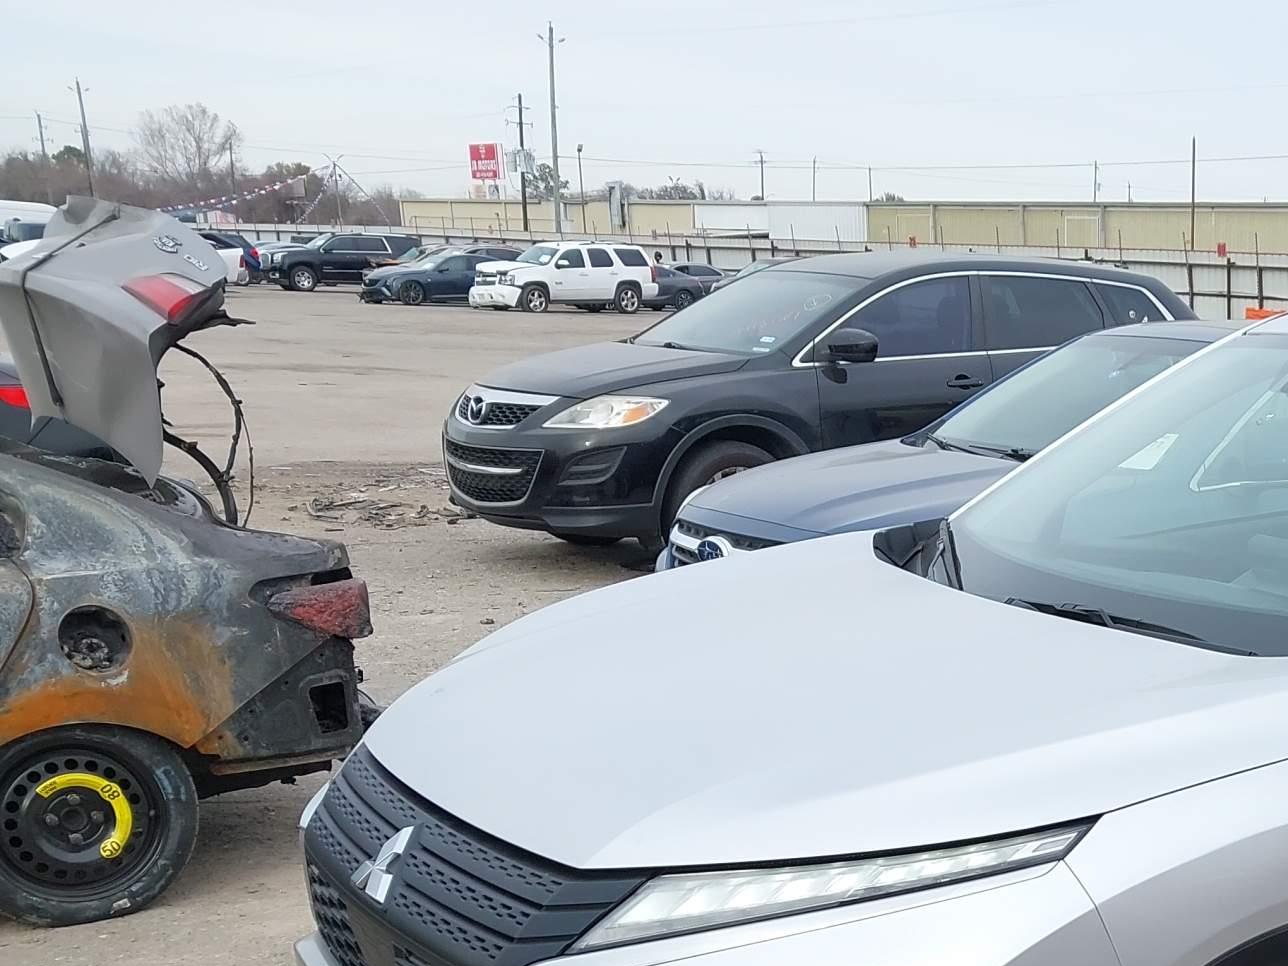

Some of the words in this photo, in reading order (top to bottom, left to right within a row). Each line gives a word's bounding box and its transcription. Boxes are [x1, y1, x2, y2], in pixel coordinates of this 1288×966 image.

[183, 254, 208, 271] RIO
[100, 783, 121, 801] 80
[101, 840, 121, 857] 50
